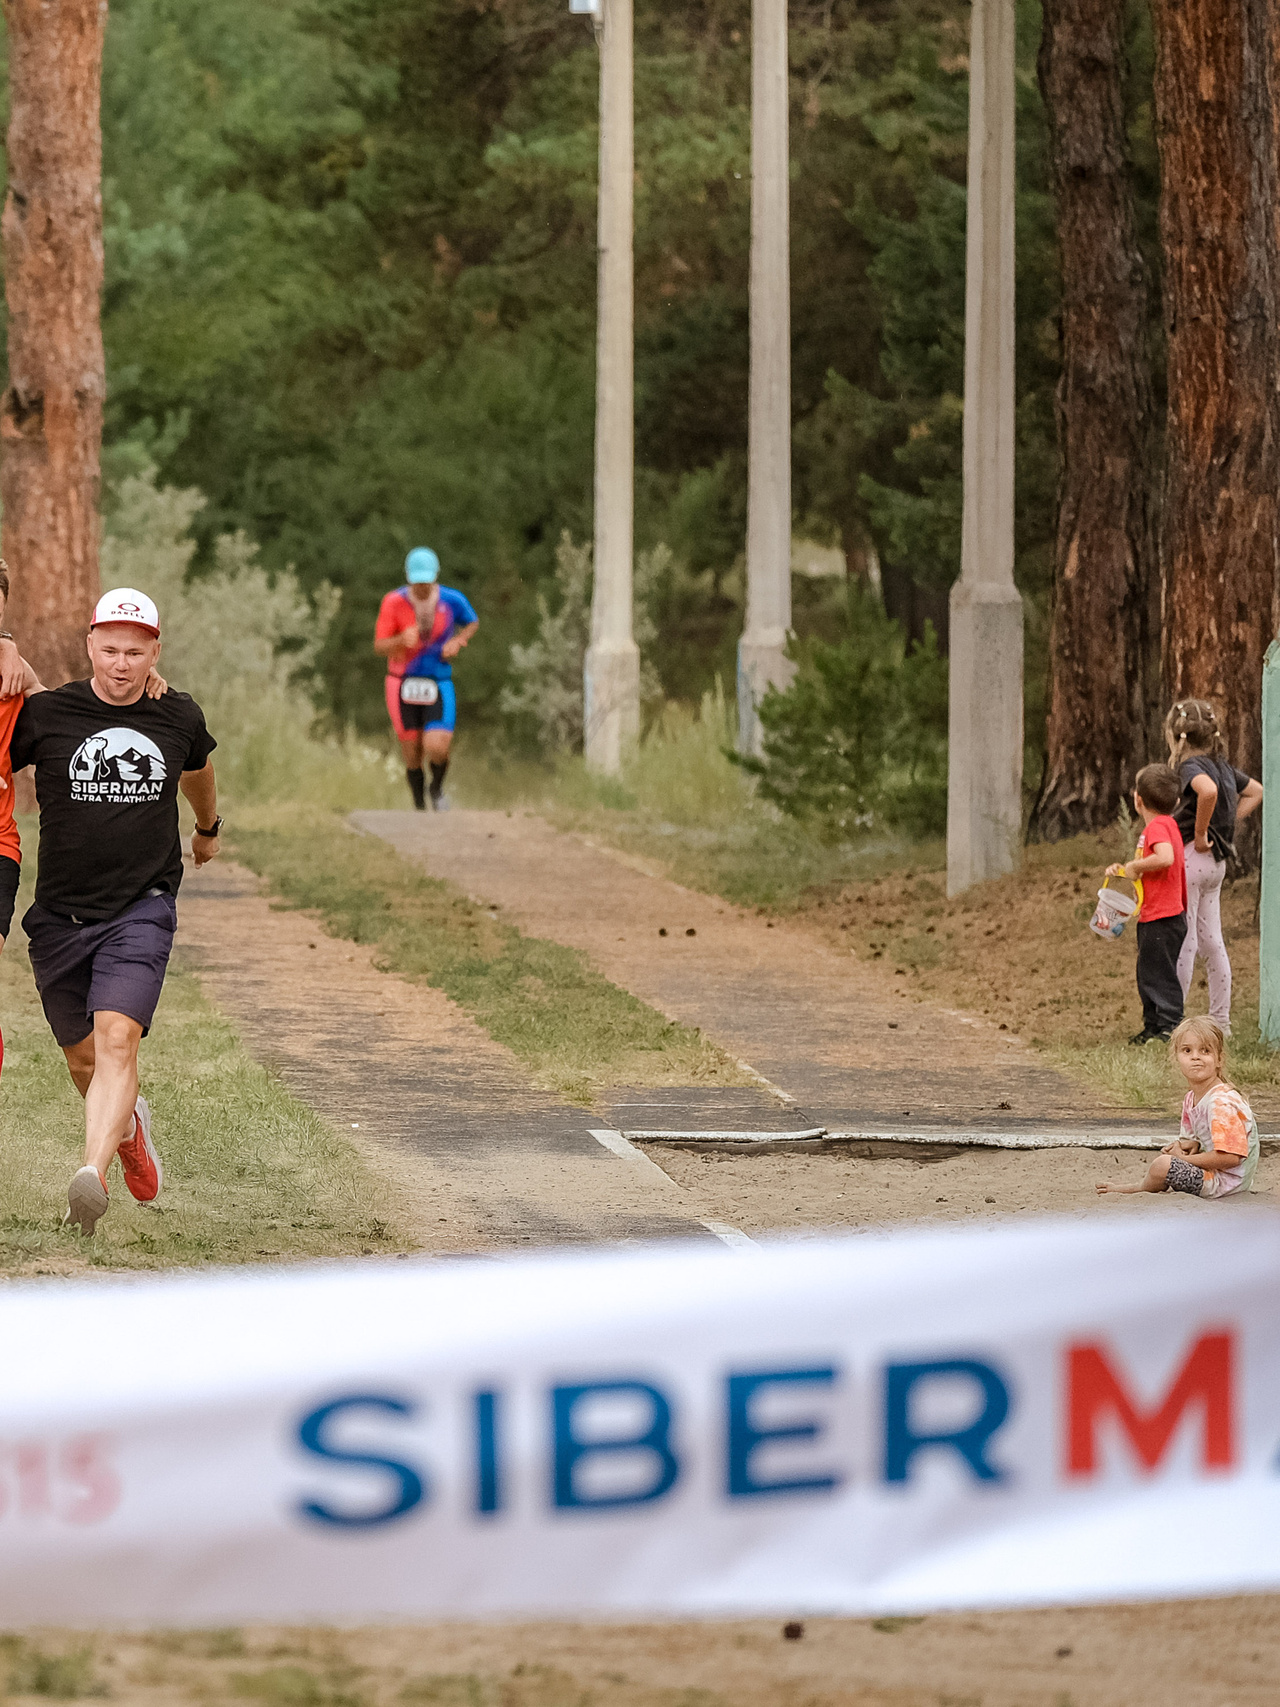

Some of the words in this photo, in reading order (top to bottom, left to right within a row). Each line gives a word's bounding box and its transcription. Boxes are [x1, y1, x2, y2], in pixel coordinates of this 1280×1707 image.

[71, 781, 163, 794] SIBERMAN
[70, 793, 102, 802] ULTRA
[107, 794, 160, 803] TRIATHLON
[293, 1320, 1280, 1532] SIBERM
